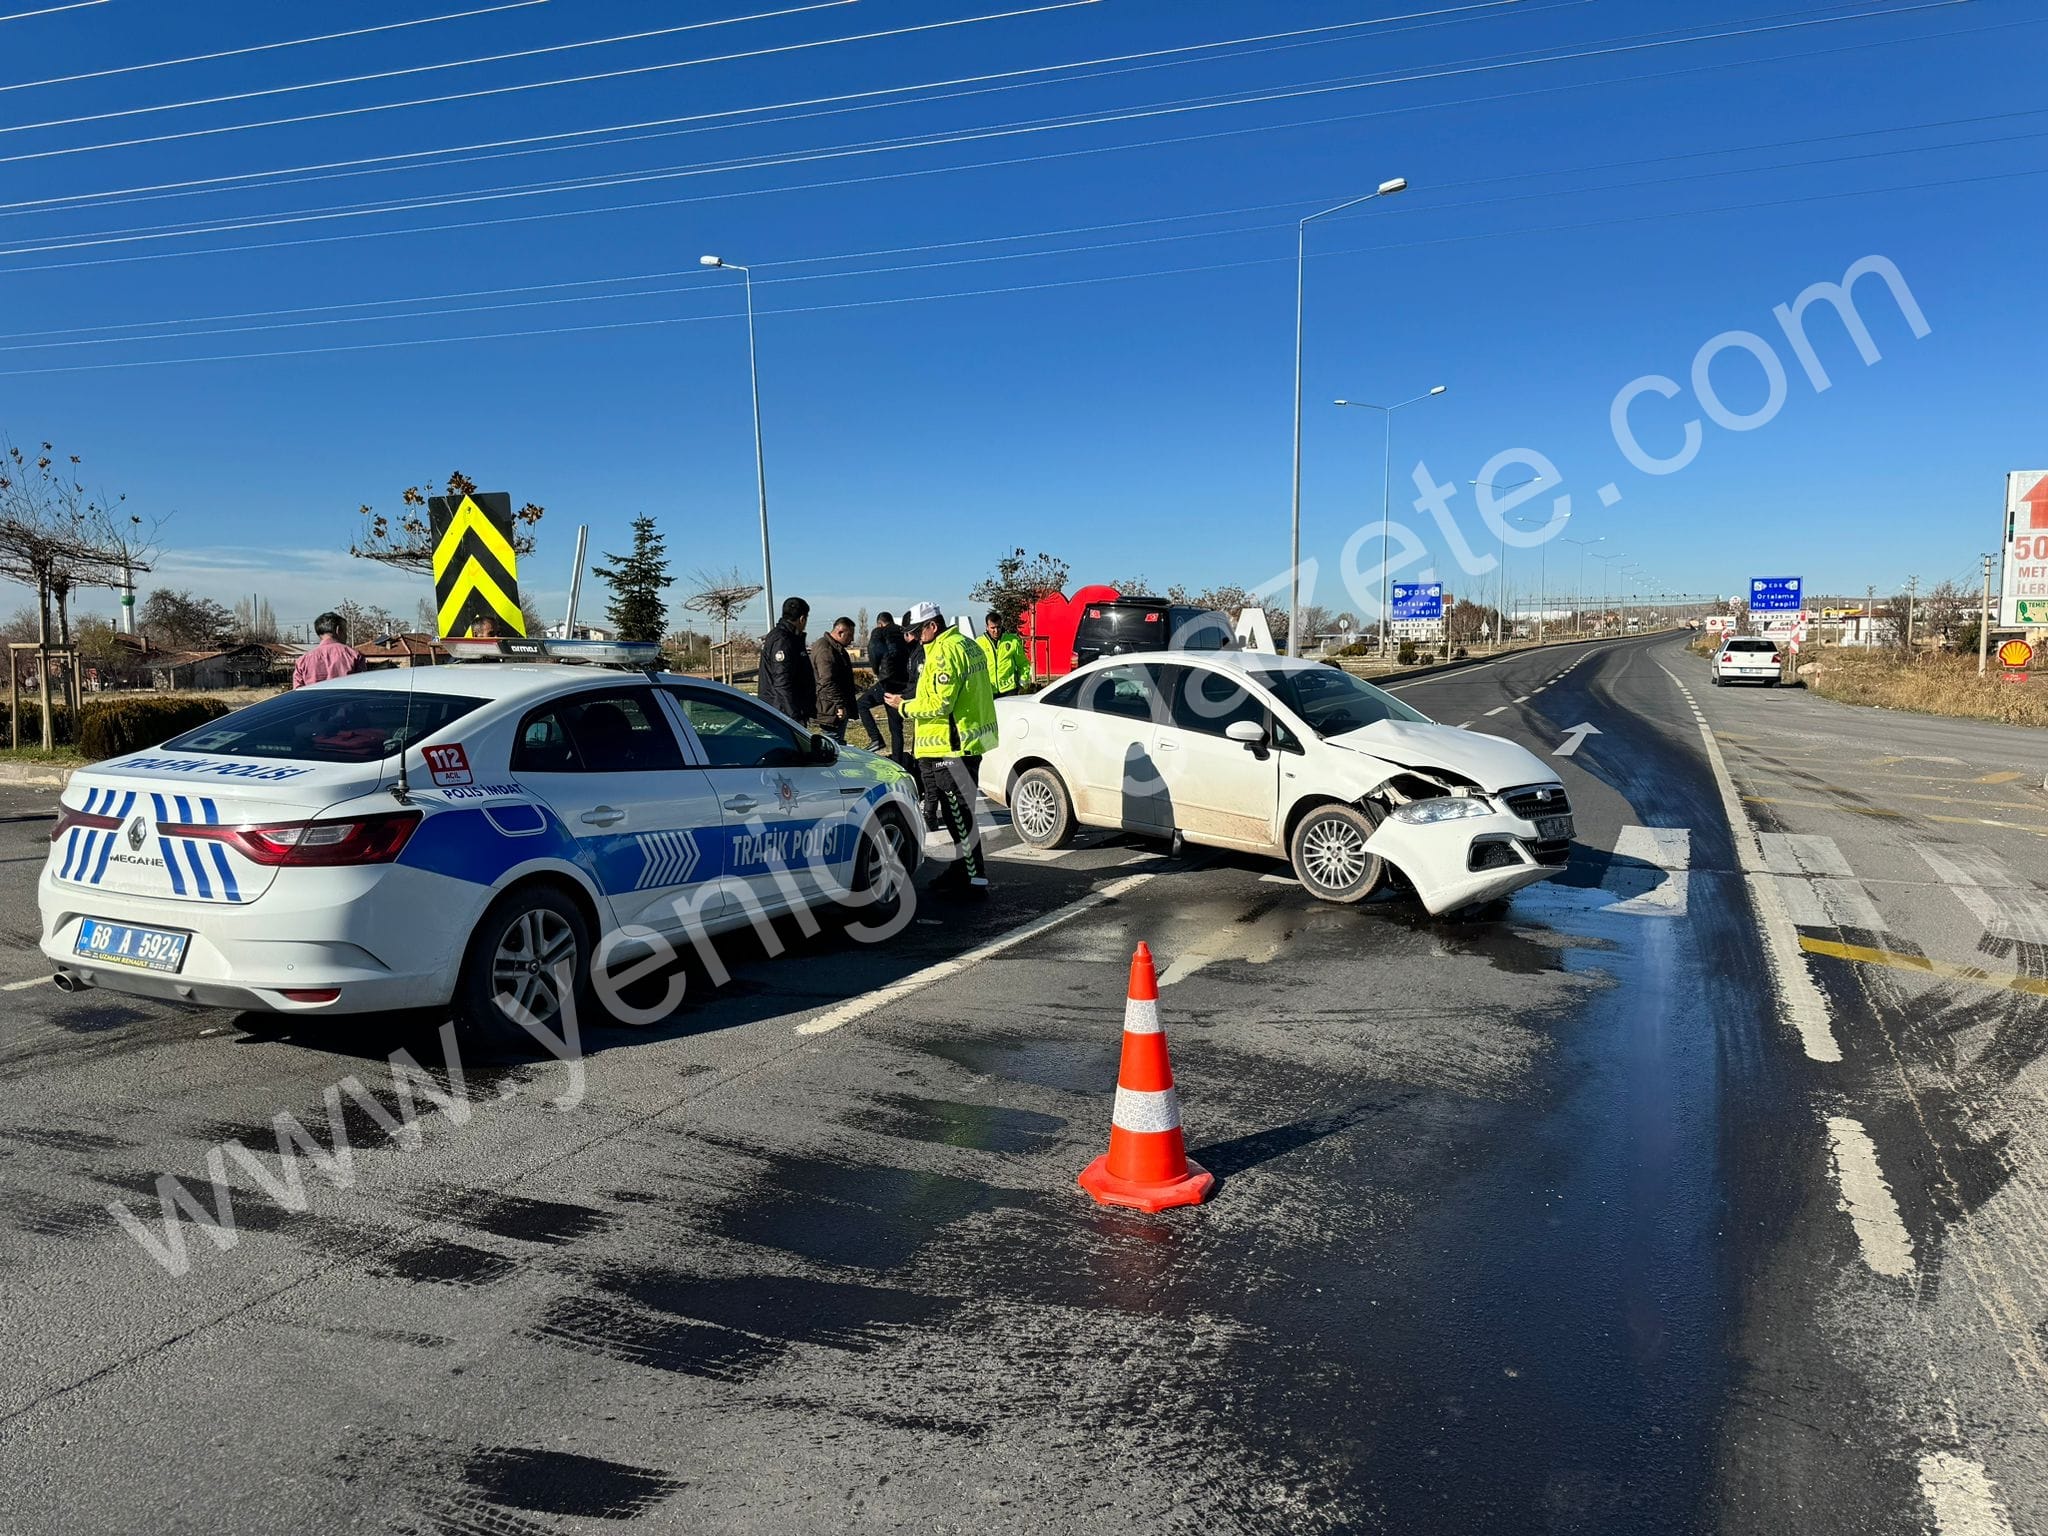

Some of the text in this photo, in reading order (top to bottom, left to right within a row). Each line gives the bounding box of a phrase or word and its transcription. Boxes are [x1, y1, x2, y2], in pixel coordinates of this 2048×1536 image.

[107, 758, 316, 781] TRAFİK POLİSİ
[429, 748, 464, 770] 112
[442, 786, 484, 800] POLİS
[732, 822, 839, 867] TRAFİK POLİSİ
[109, 855, 164, 868] MEGANE
[90, 924, 112, 950] 68
[117, 929, 132, 954] A
[138, 932, 179, 963] 5924
